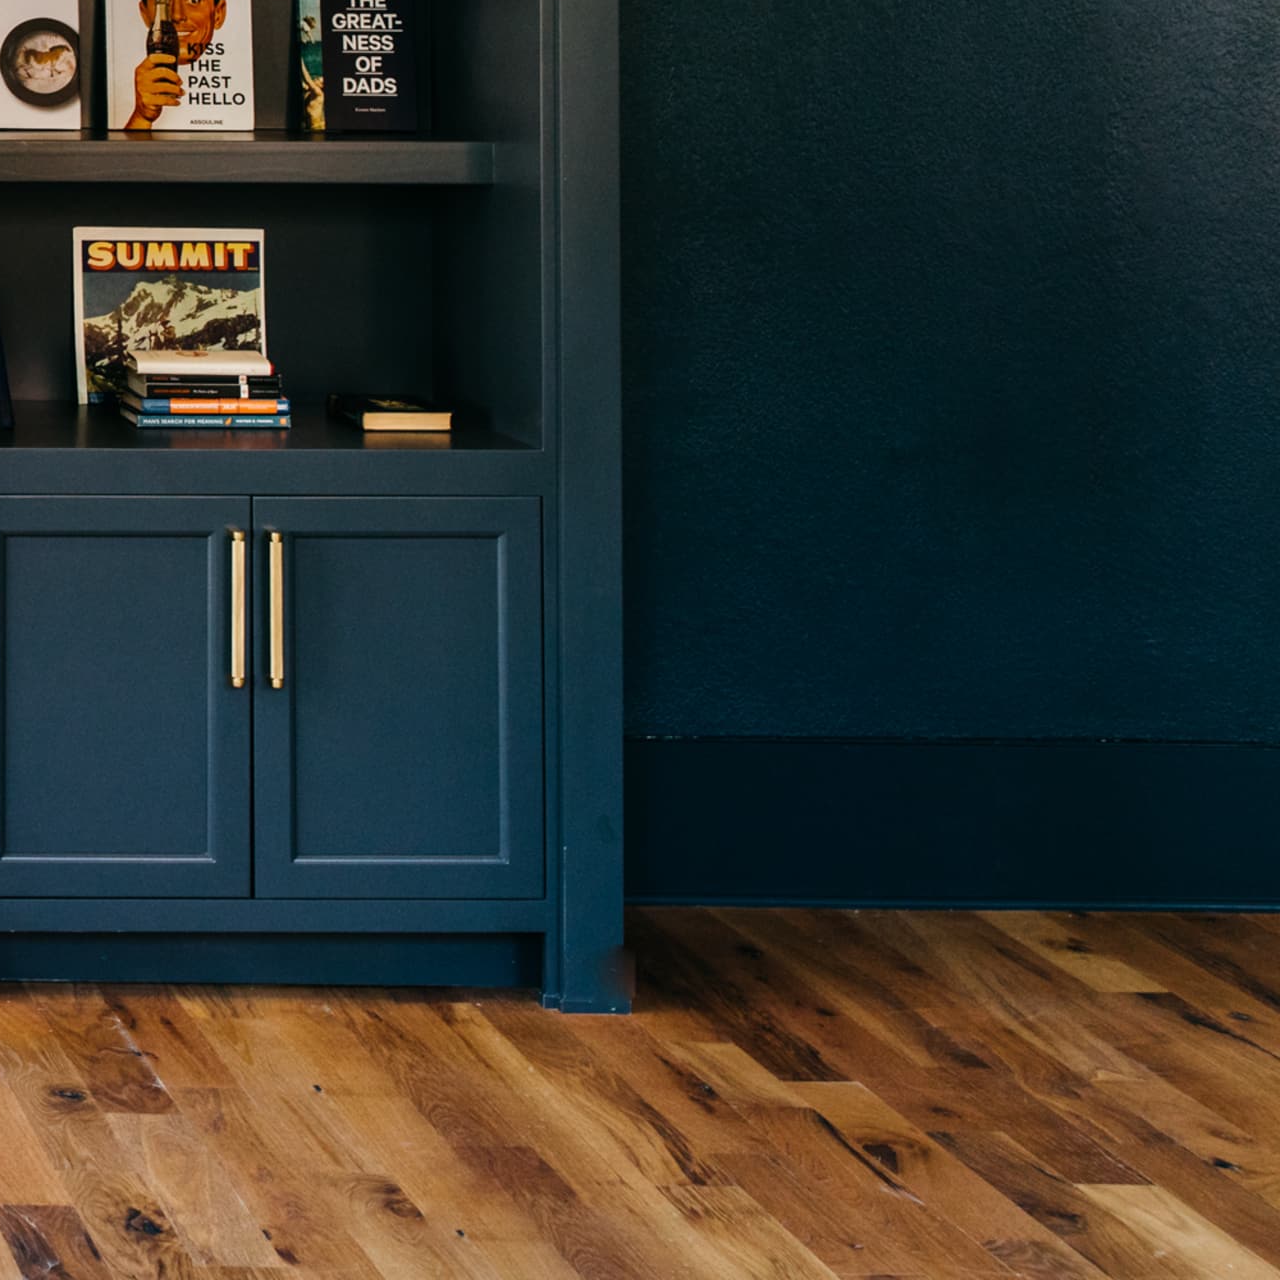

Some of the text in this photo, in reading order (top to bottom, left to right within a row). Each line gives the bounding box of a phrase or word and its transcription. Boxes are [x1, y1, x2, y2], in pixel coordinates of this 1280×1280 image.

[331, 13, 403, 29] GREAT-
[187, 43, 225, 56] KISS
[342, 35, 394, 51] NESS
[188, 60, 221, 72] THE
[355, 56, 382, 72] OF
[188, 76, 231, 88] PAST
[343, 78, 397, 94] DADS
[188, 92, 246, 105] HELLO
[87, 241, 255, 271] SUMMIT
